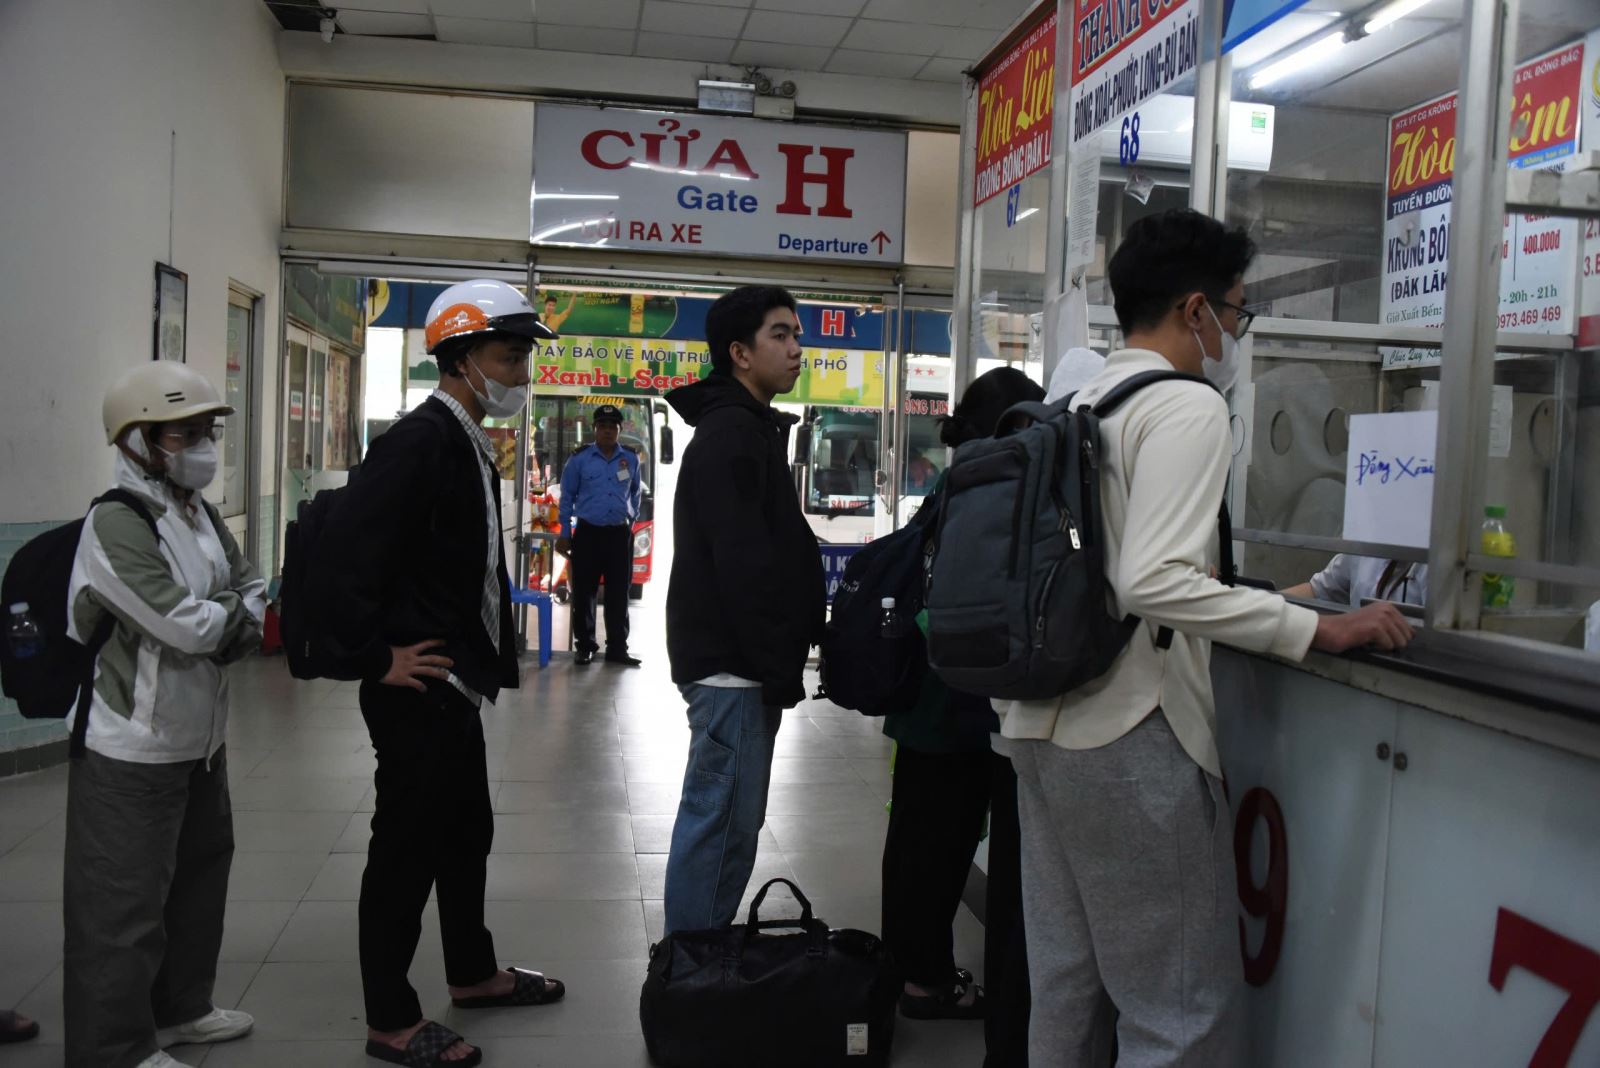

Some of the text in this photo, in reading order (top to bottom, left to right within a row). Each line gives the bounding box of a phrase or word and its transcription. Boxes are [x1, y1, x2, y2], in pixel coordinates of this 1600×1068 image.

[1120, 111, 1140, 168] 68
[580, 118, 855, 218] CỬA H
[676, 185, 758, 213] Gate
[1007, 183, 1020, 229] 67
[629, 221, 663, 242] RA
[670, 223, 703, 244] XE
[778, 233, 868, 255] Departure
[1537, 284, 1558, 300] 21h
[821, 310, 845, 337] H
[1541, 305, 1561, 322] 469
[536, 345, 566, 358] TAY
[572, 342, 609, 360] BẢO
[614, 347, 635, 364] VỆ
[641, 346, 673, 362] MÔI
[813, 355, 848, 371] PHỐ
[537, 365, 611, 387] Xanh
